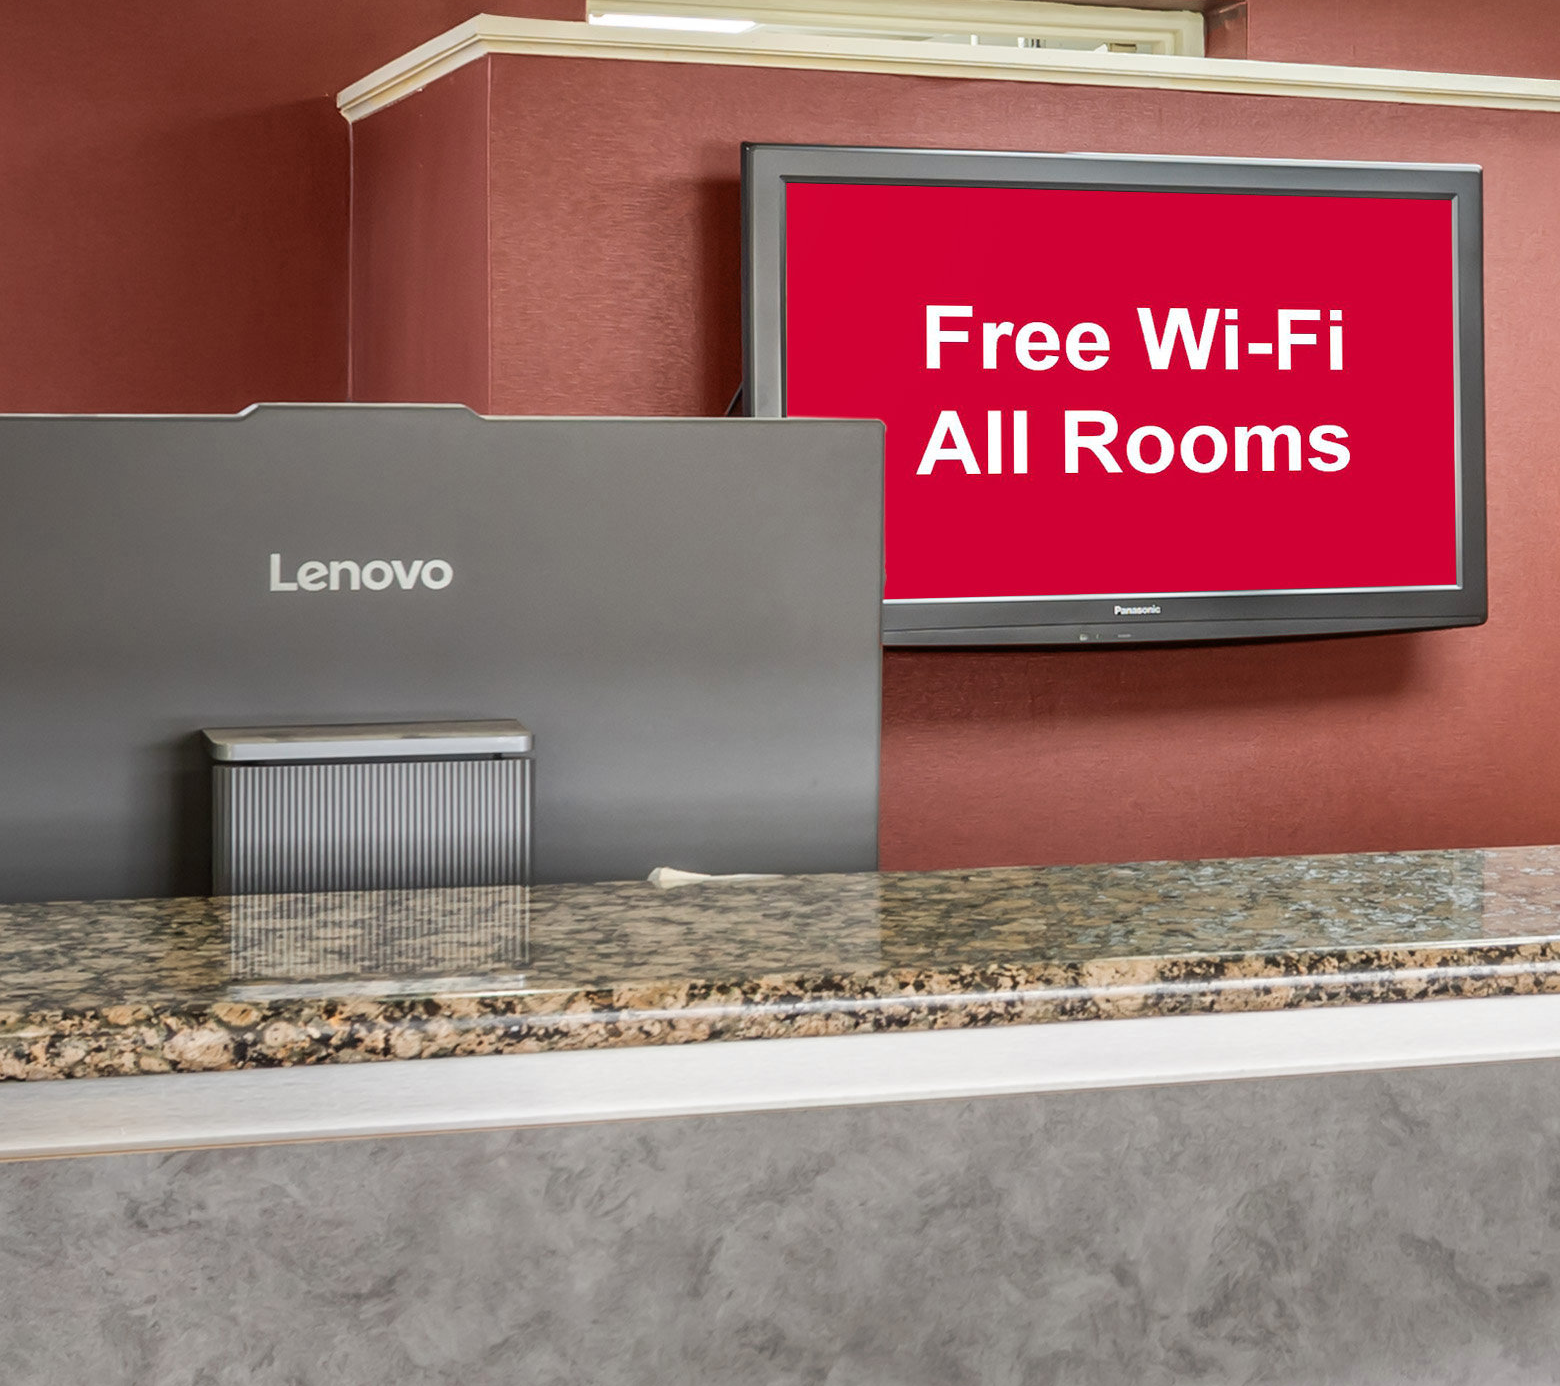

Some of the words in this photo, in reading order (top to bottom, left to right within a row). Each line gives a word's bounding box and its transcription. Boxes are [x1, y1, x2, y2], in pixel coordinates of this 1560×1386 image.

[926, 305, 1110, 371] Free
[1137, 308, 1343, 370] Wi-Fi
[916, 410, 1027, 475] All
[1065, 410, 1350, 473] Rooms
[271, 554, 453, 591] Lenovo
[1114, 605, 1160, 615] Panasonic
